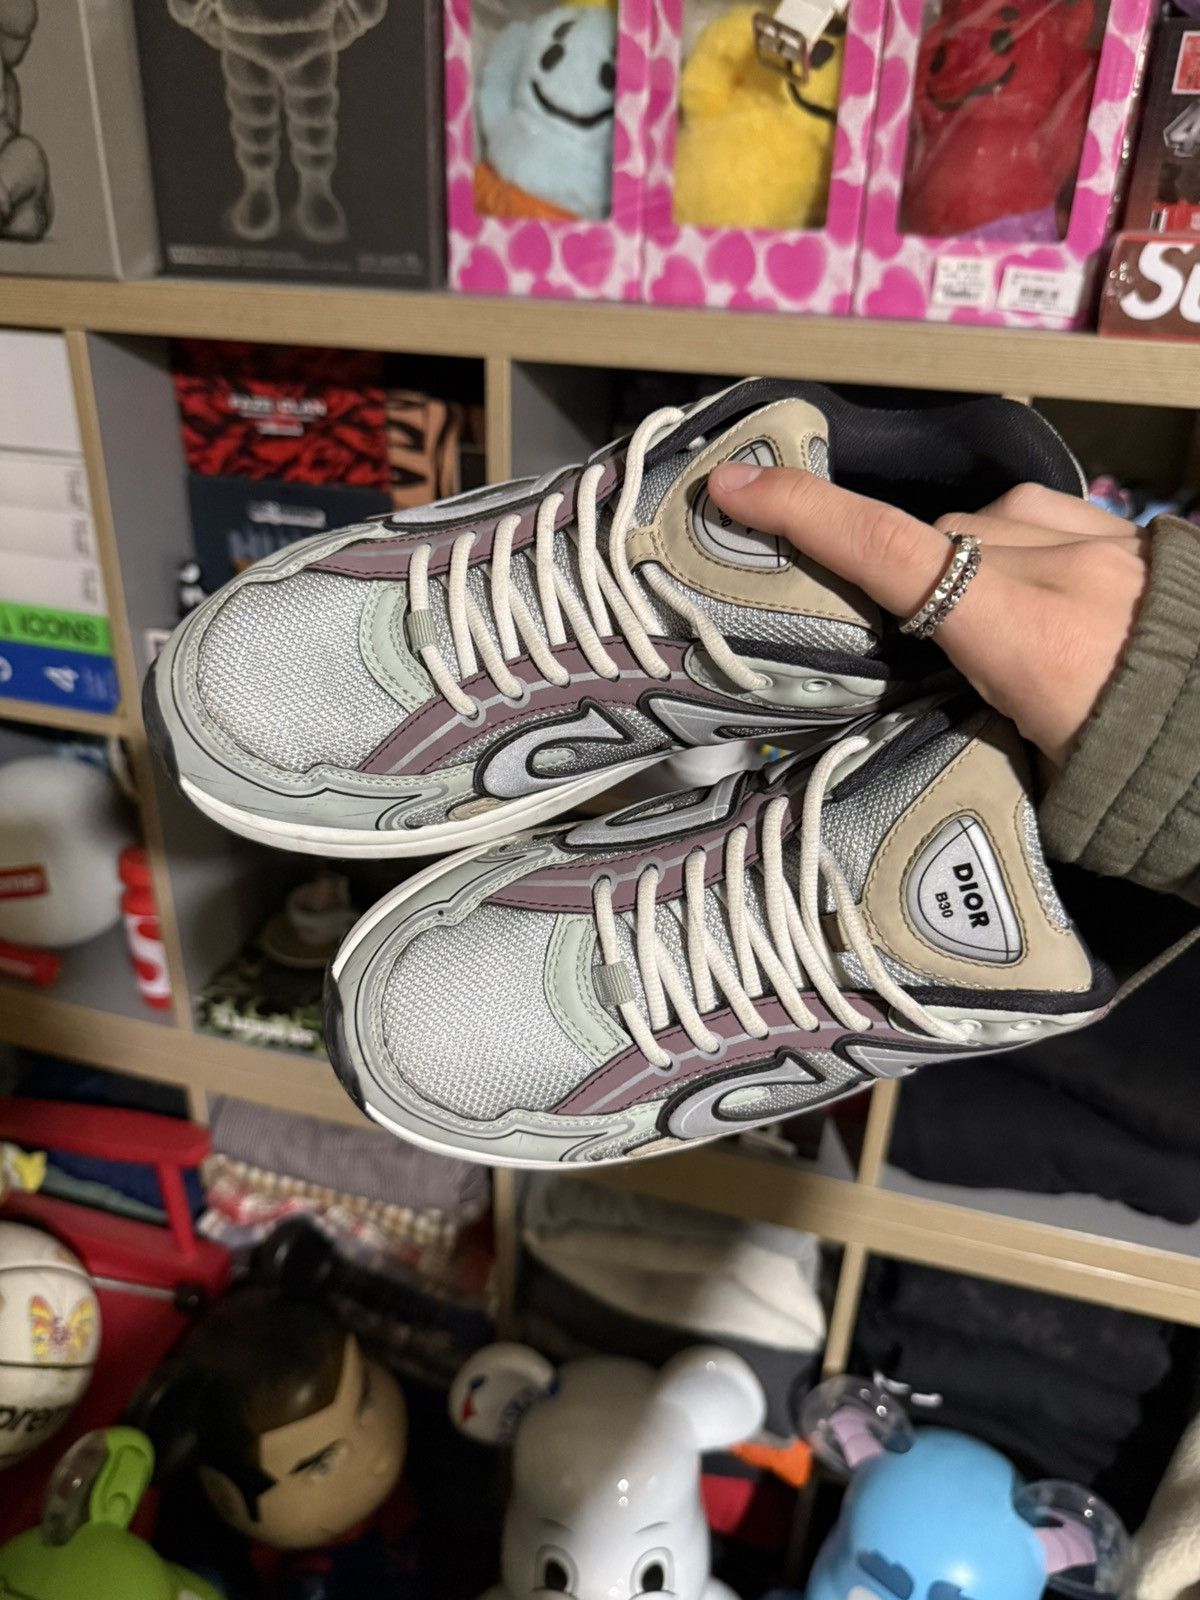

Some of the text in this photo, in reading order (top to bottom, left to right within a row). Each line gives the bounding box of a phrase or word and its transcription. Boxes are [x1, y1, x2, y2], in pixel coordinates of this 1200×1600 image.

[20, 611, 99, 646] ICONS
[934, 891, 954, 919] B30
[952, 862, 990, 930] DIOR
